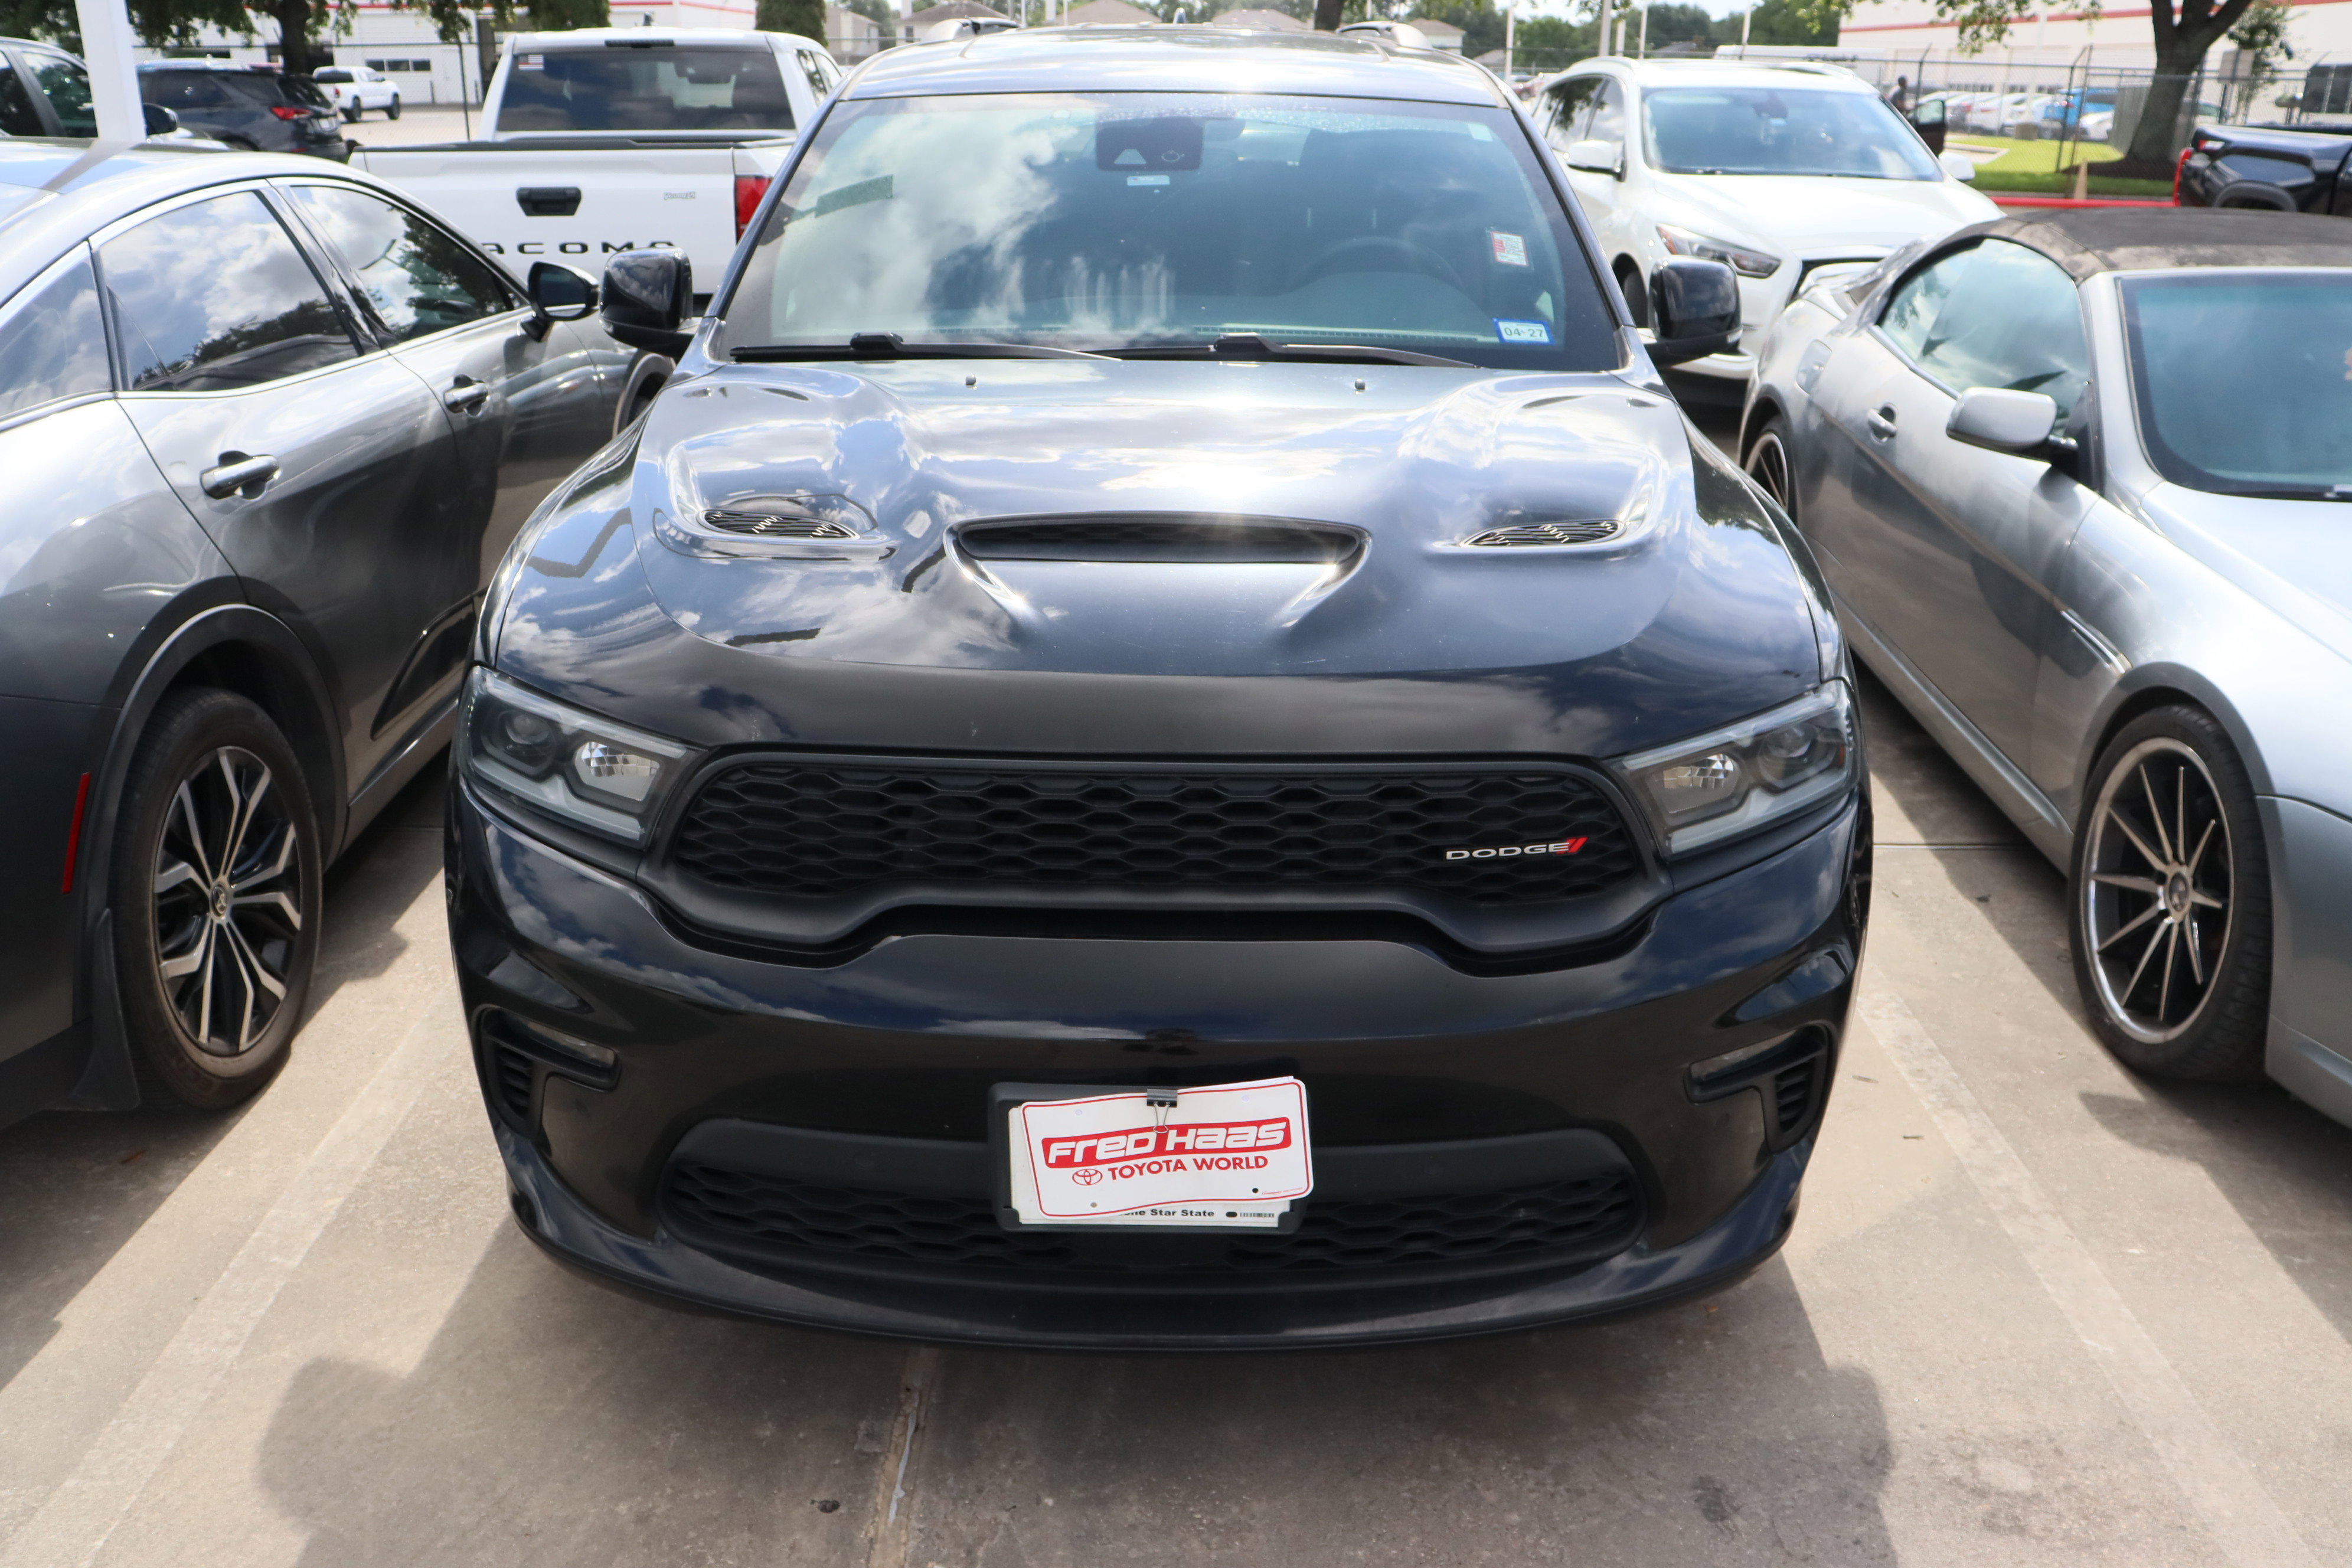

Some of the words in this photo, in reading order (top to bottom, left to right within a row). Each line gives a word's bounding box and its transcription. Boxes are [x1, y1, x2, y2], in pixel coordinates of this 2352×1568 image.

[1446, 842, 1570, 860] DODGE
[1108, 1159, 1188, 1180] TOYOTA
[1193, 1155, 1268, 1171] WORLD
